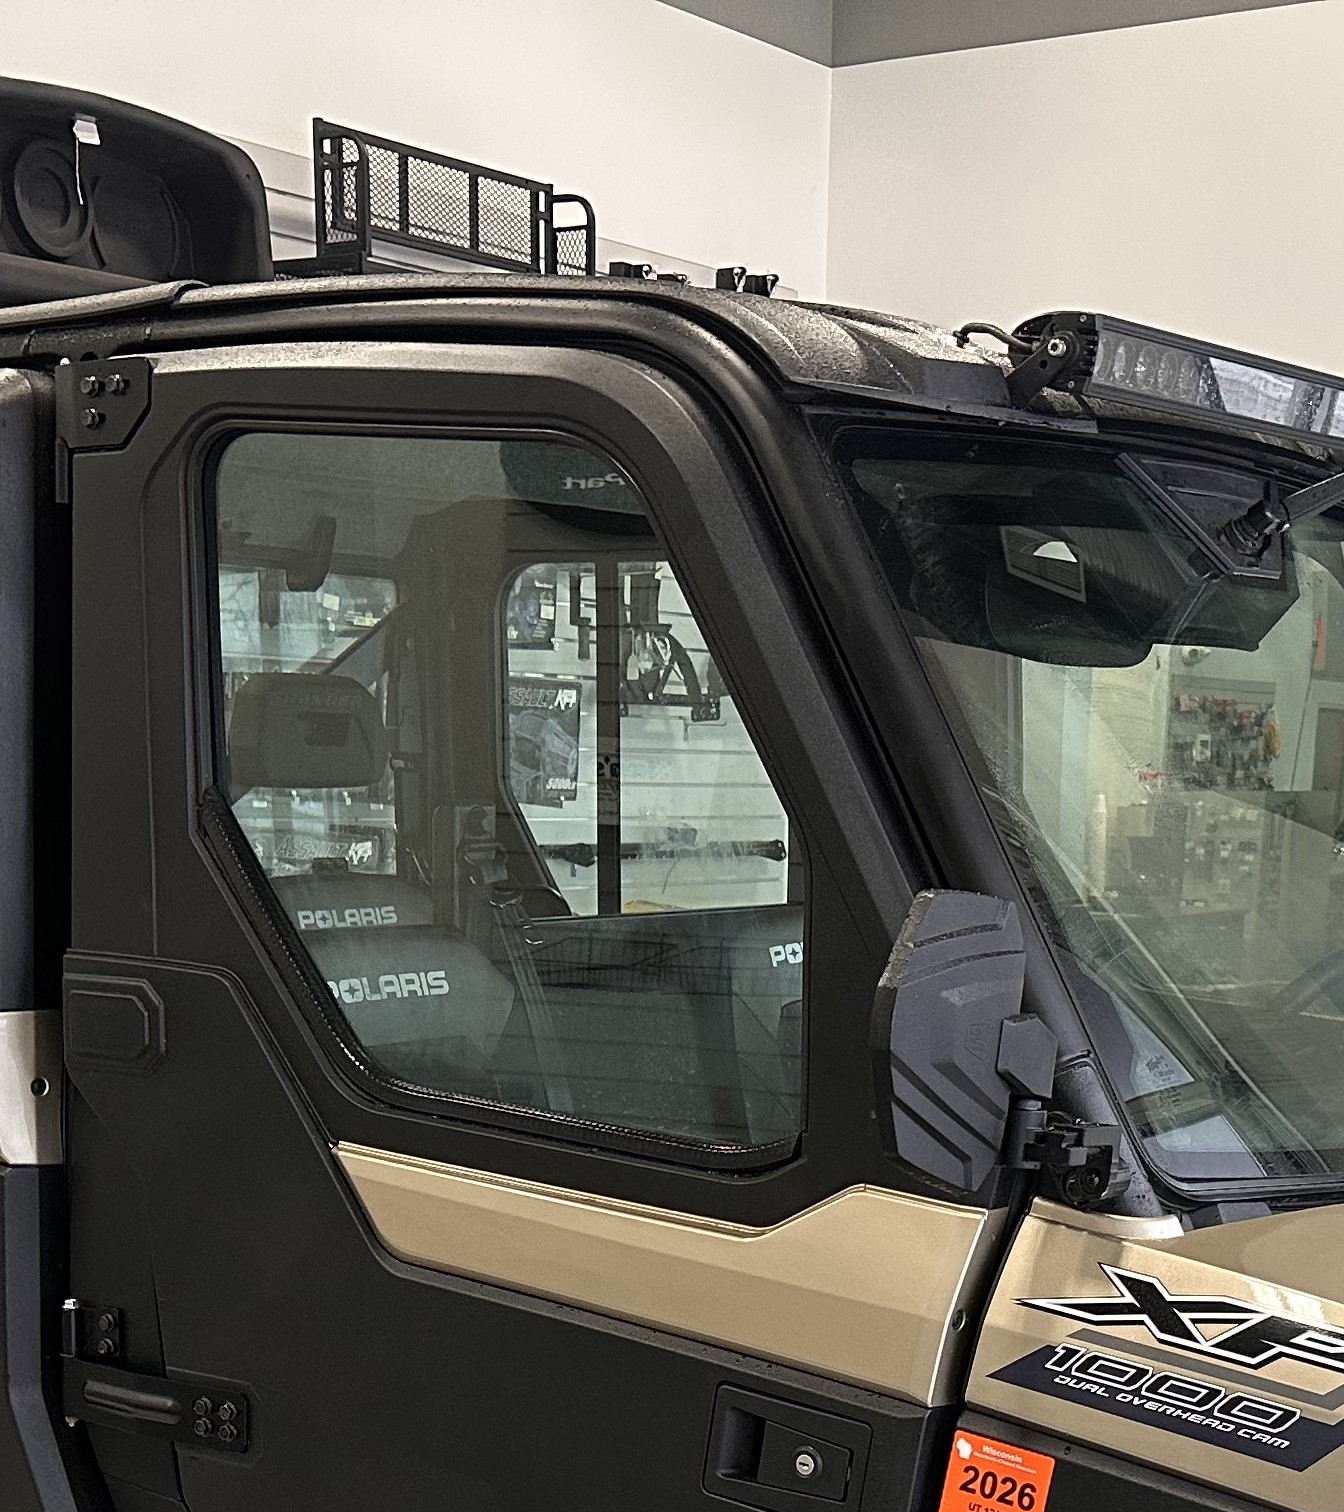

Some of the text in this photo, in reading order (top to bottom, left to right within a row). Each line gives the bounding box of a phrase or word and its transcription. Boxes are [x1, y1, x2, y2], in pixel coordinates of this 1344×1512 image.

[297, 905, 398, 930] POLARIS
[1044, 1342, 1302, 1433] 1000
[1053, 1374, 1291, 1449] DUAL OVERHEAD CAM
[958, 1464, 1038, 1512] 2026
